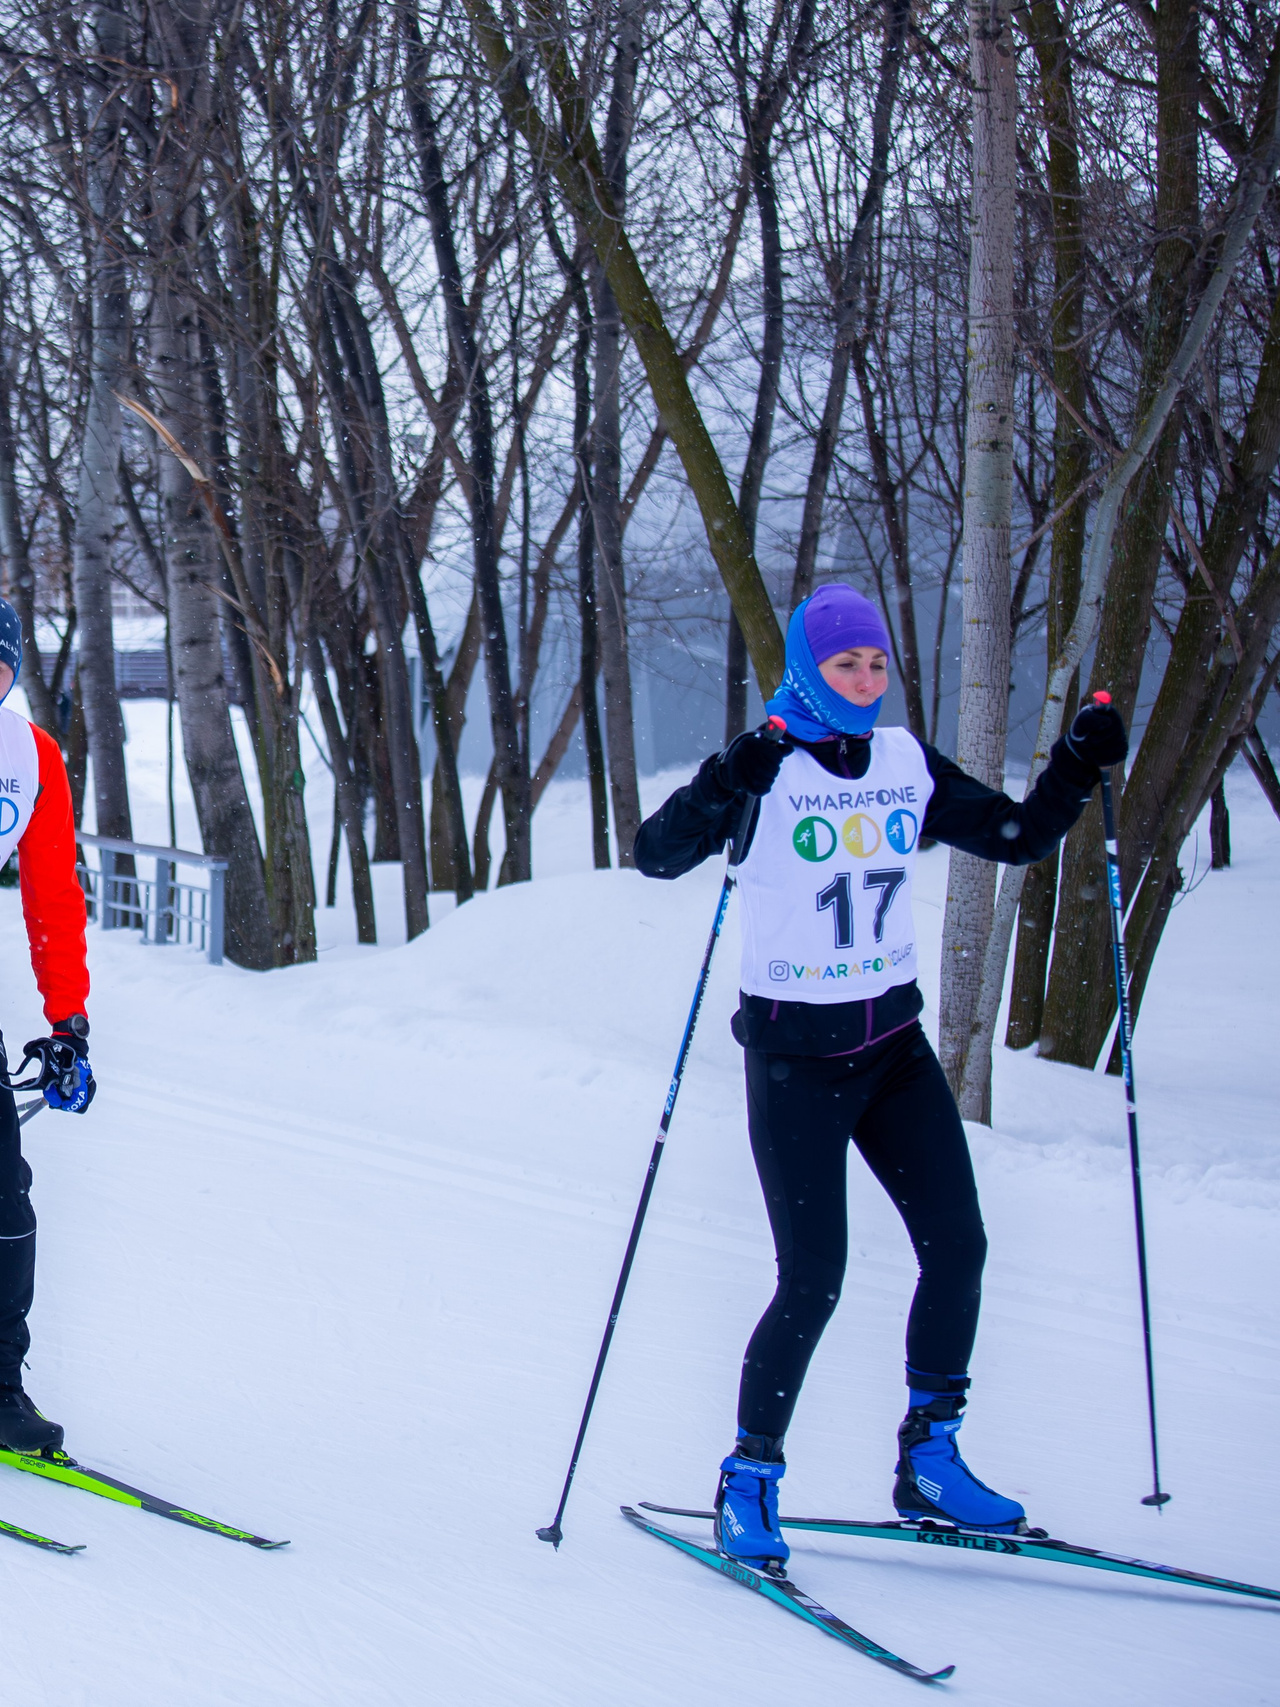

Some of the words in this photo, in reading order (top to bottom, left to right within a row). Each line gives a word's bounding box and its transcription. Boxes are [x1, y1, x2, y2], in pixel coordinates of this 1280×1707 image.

[789, 786, 918, 812] VMARAFONE
[816, 866, 907, 949] 17
[19, 1456, 46, 1470] FISCHER
[733, 1462, 773, 1475] SPINE
[169, 1509, 255, 1540] FISCHER
[722, 1502, 746, 1537] SPINE
